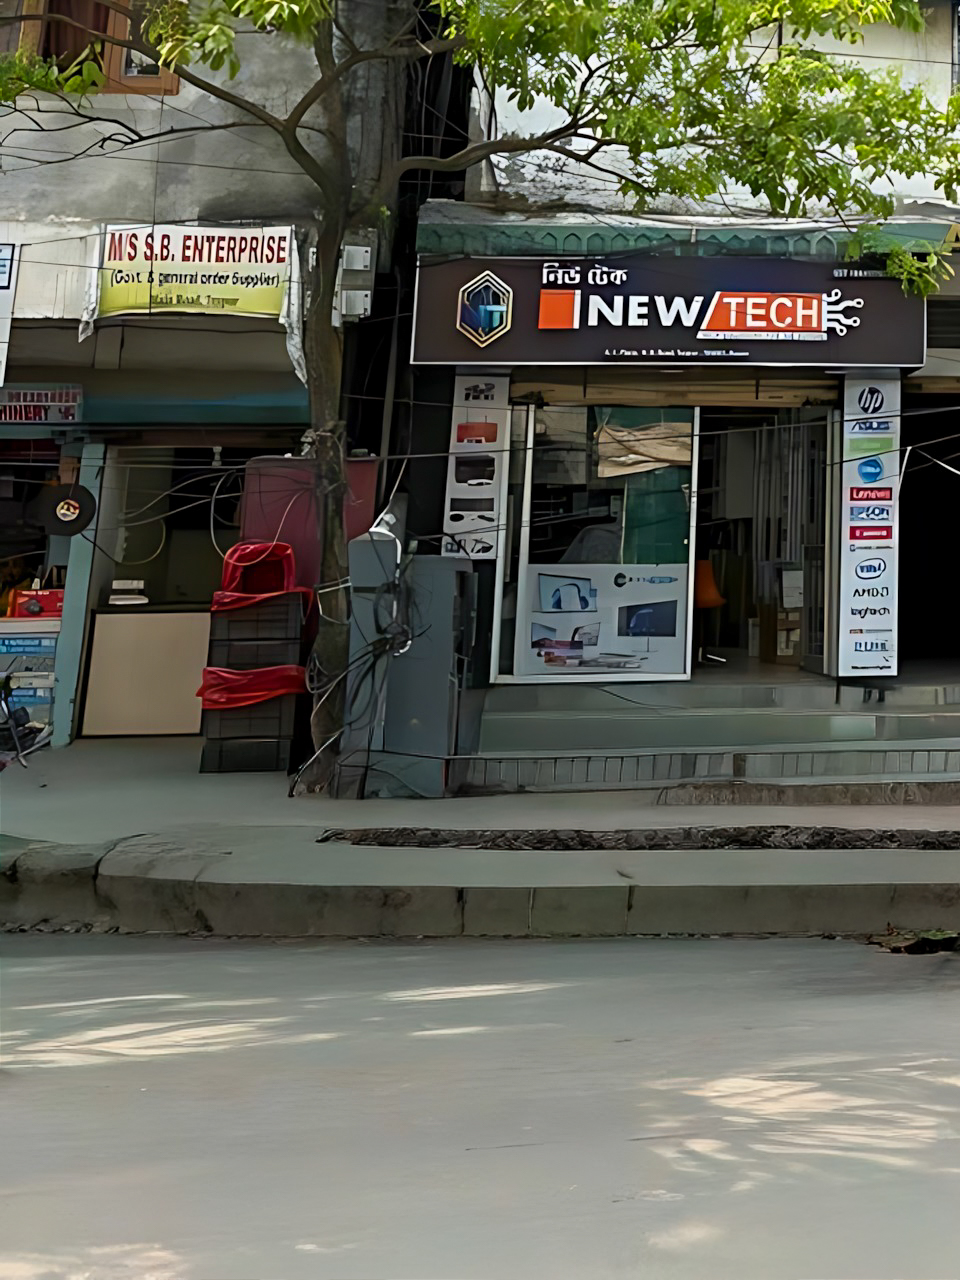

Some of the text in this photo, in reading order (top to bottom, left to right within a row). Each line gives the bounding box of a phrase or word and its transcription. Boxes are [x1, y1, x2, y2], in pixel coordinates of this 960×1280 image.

[181, 234, 287, 264] ENTERPRISE
[200, 271, 230, 285] order
[588, 295, 819, 328] NEW TECH
[859, 387, 883, 413] hp
